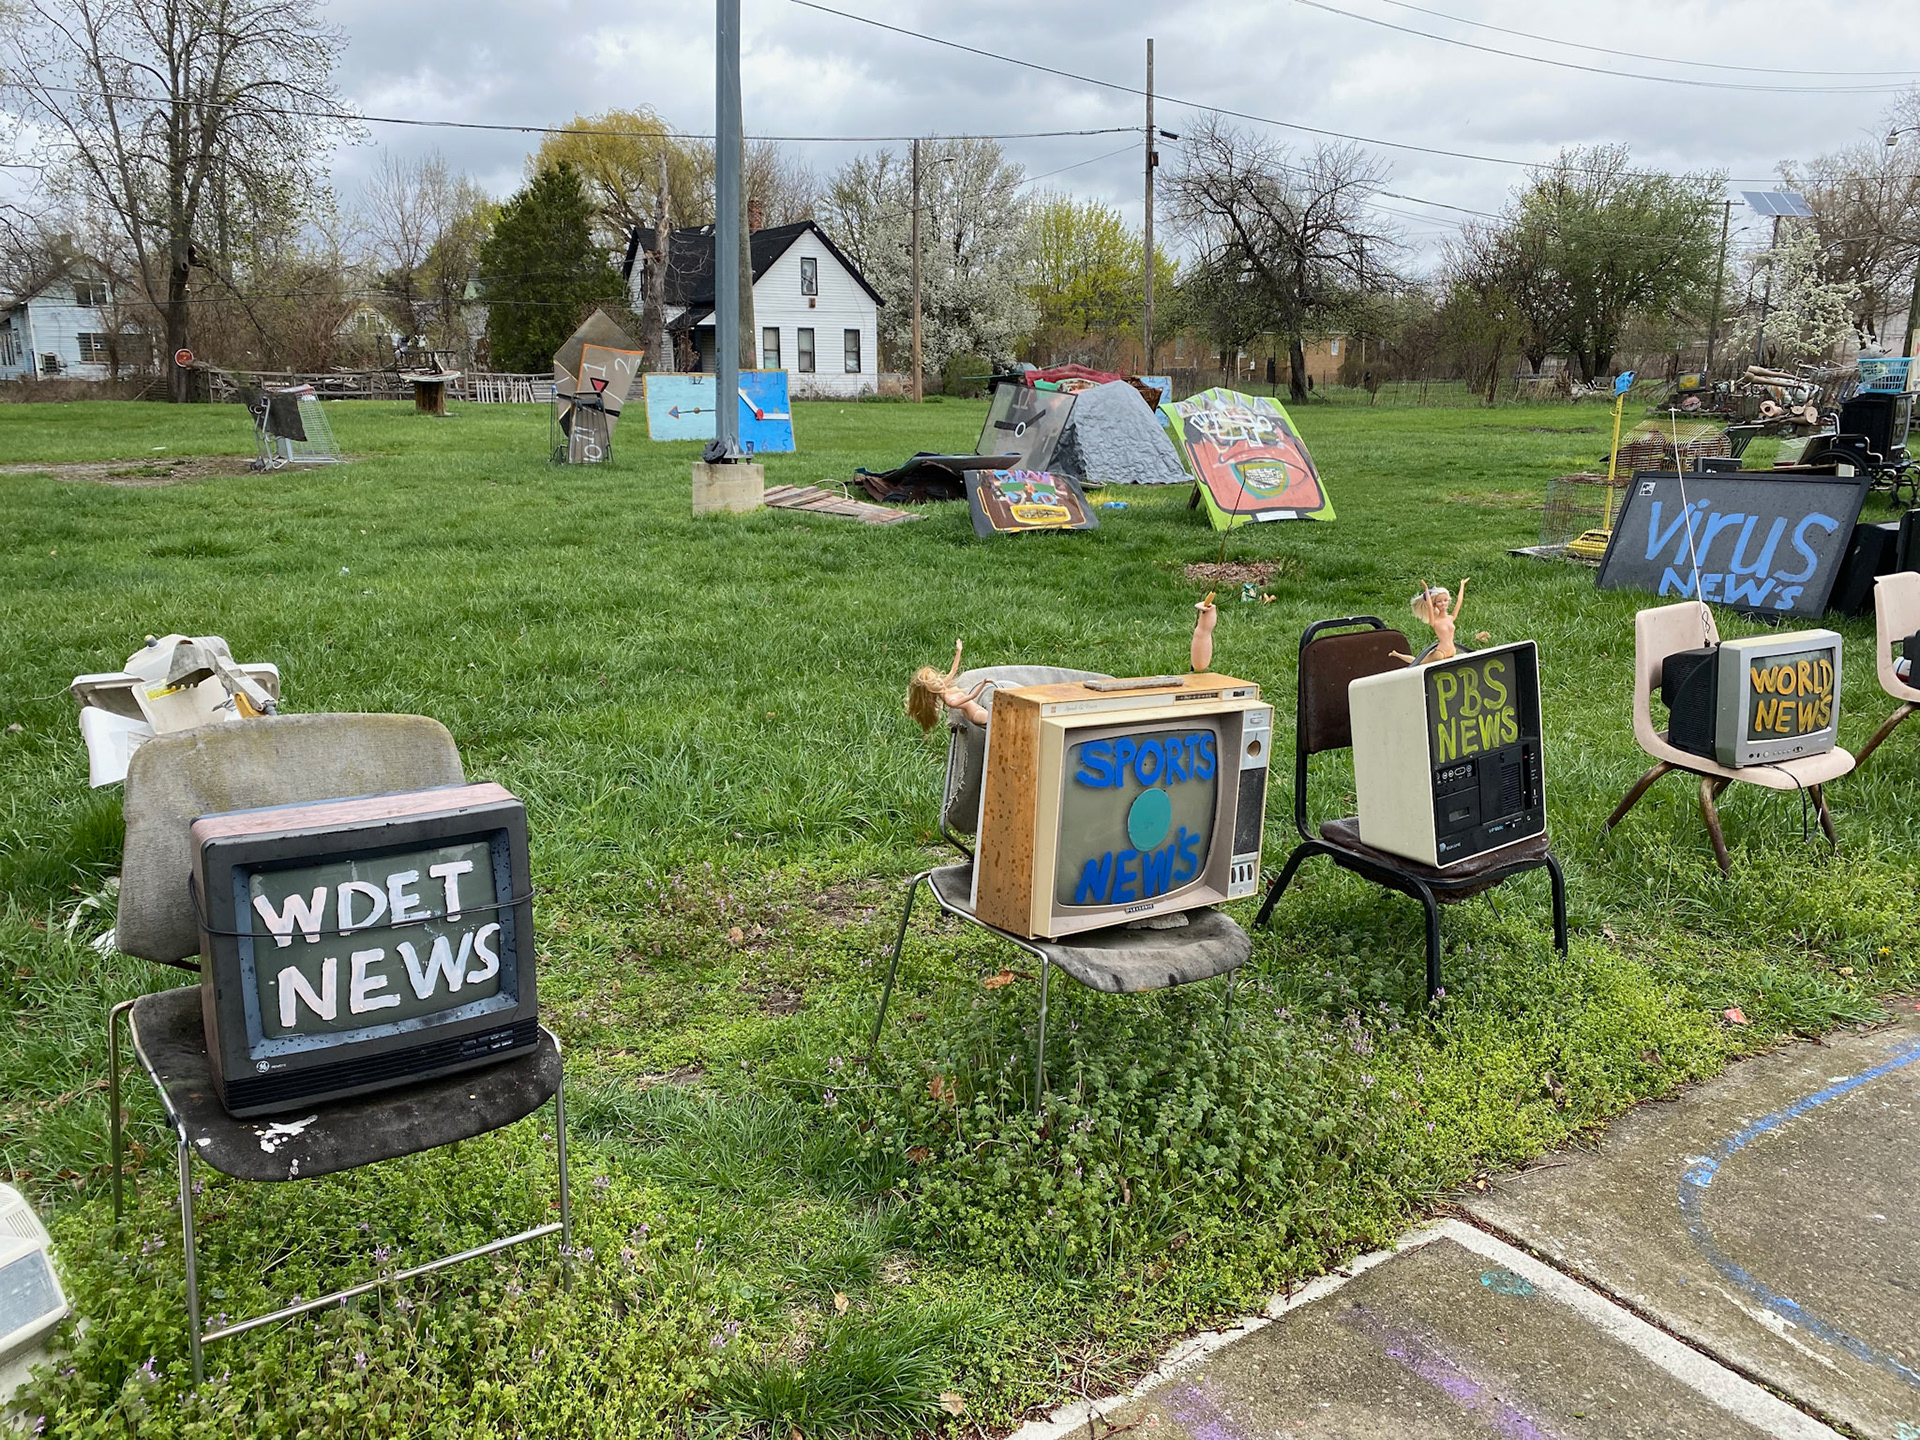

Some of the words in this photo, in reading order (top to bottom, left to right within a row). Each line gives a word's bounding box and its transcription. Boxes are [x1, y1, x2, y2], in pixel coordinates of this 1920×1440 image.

[1645, 498, 1840, 583] Virus
[1657, 566, 1805, 611] NEW'S
[1433, 658, 1509, 721] PBS
[1750, 659, 1834, 699] WORLD
[1075, 732, 1217, 789] SPORTS
[1437, 704, 1519, 764] NEWS
[253, 859, 475, 949] WDET
[276, 922, 502, 1028] NEWS
